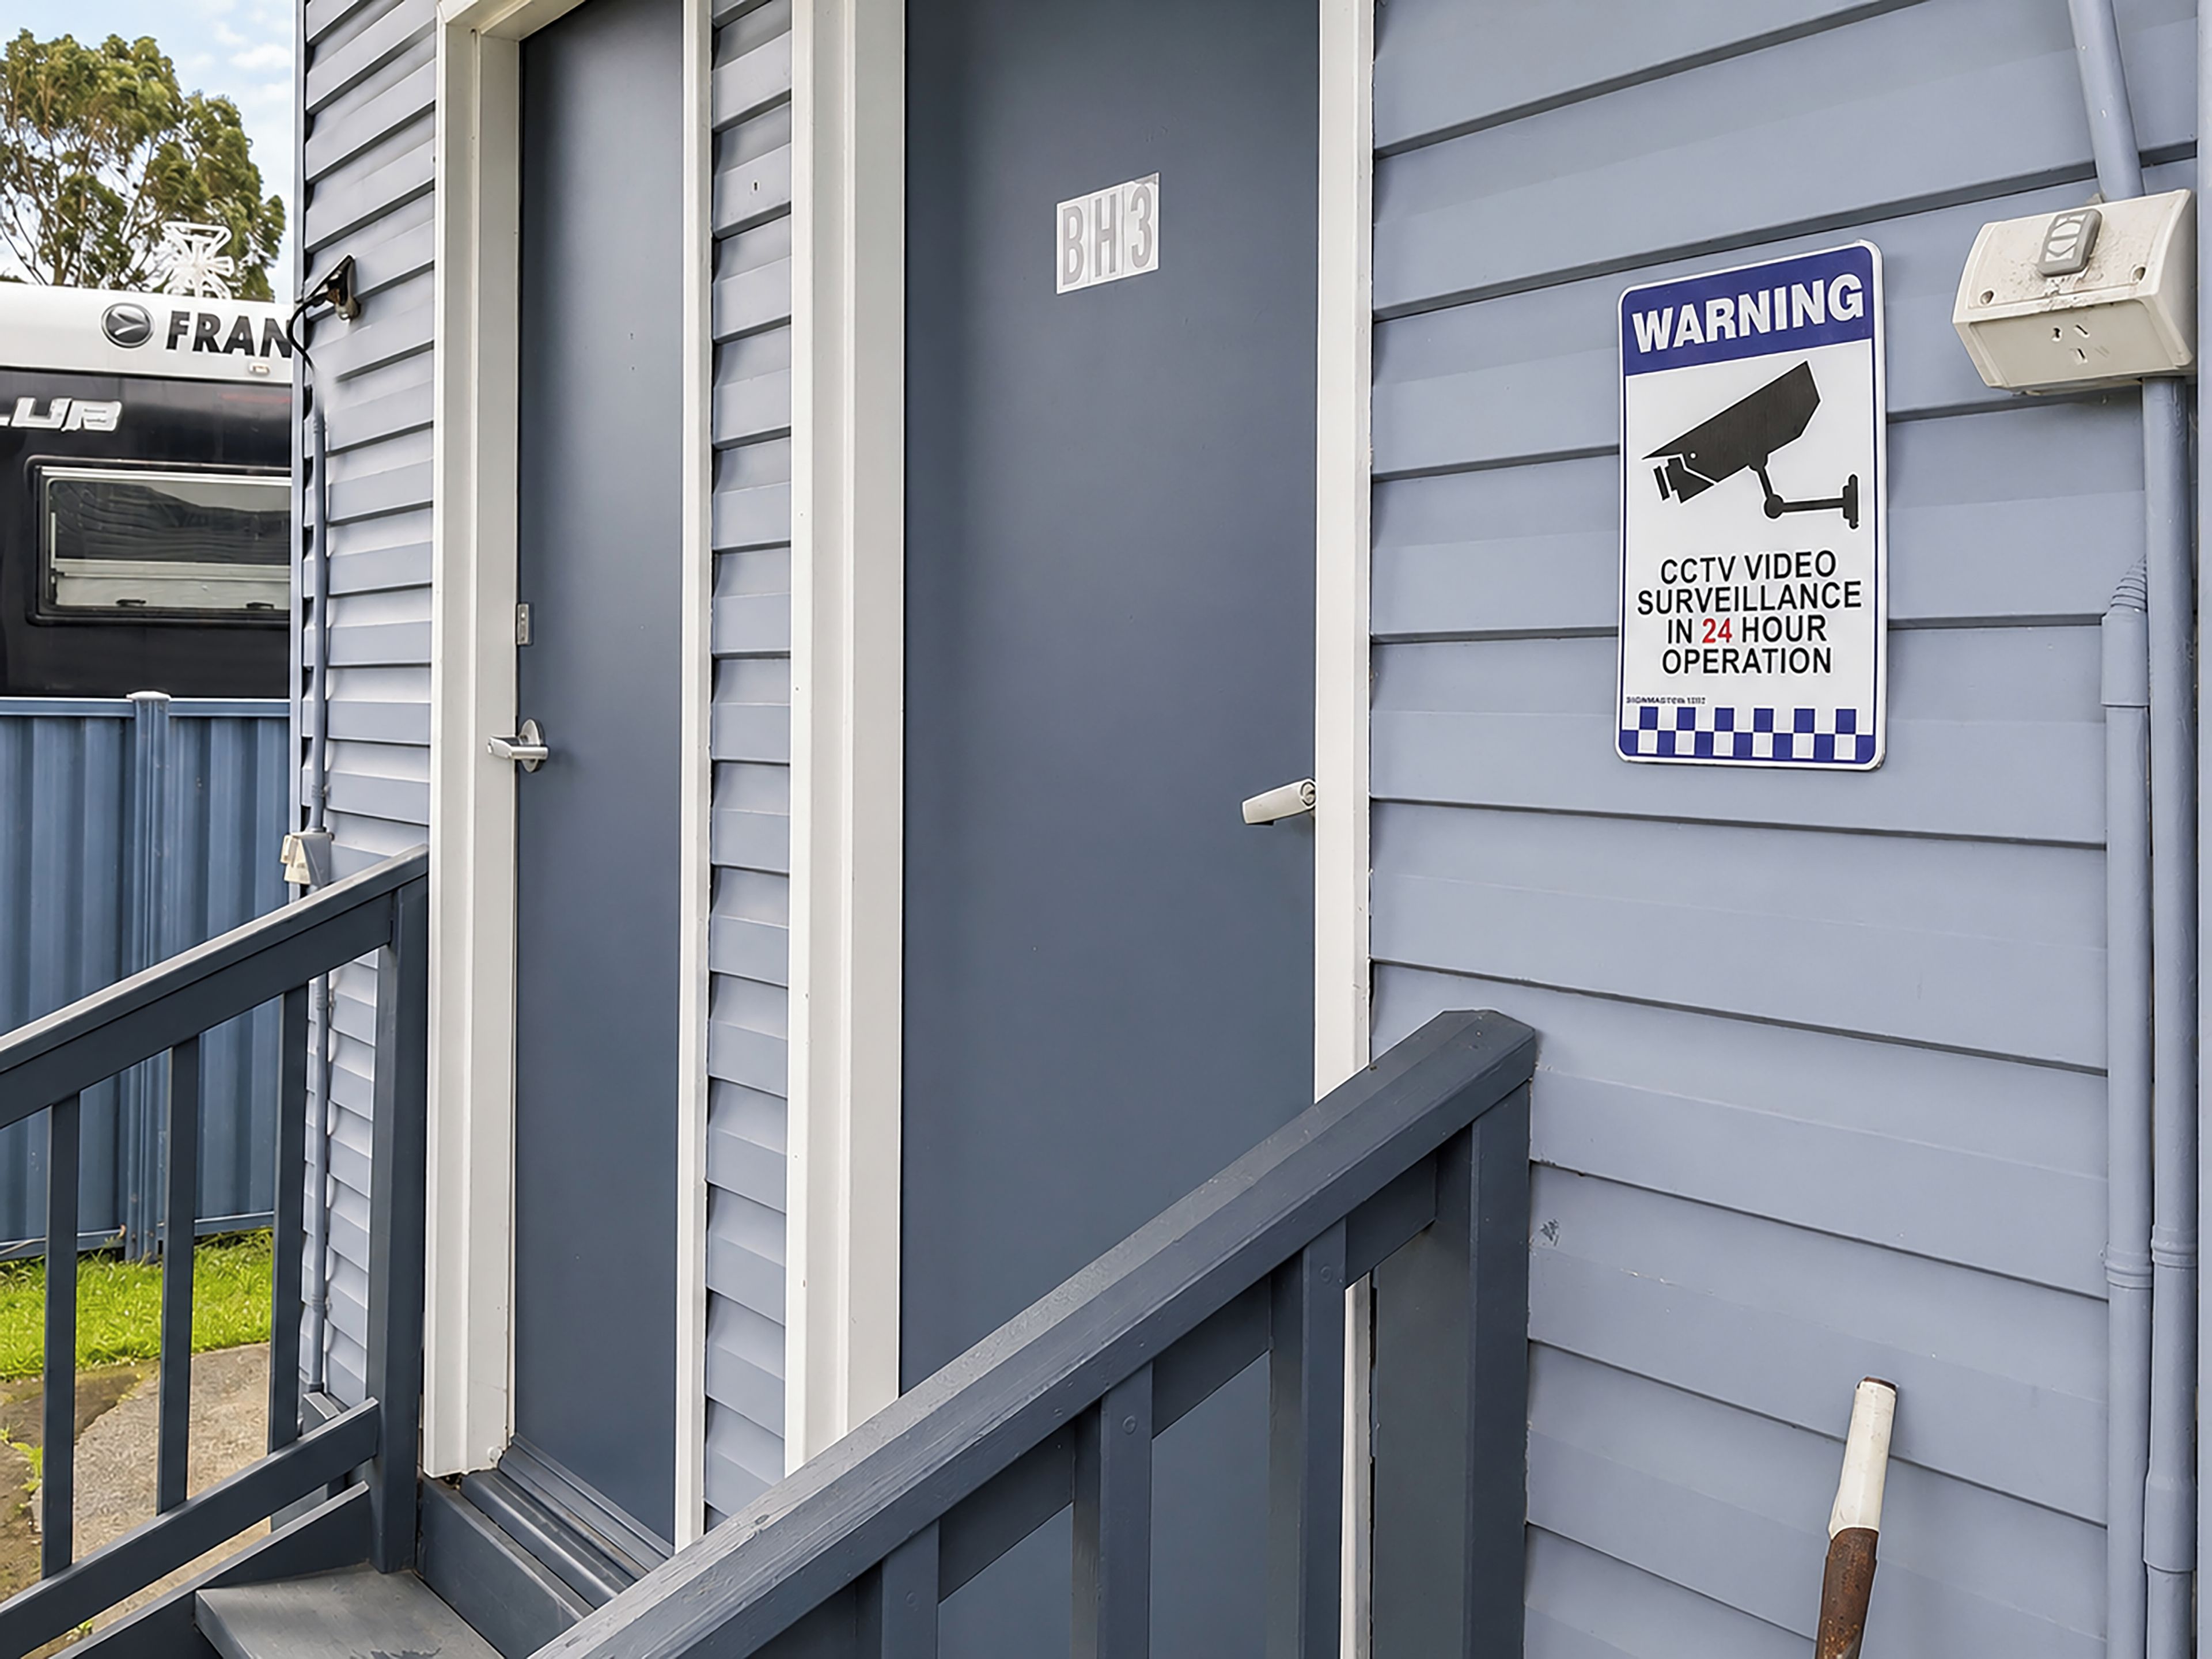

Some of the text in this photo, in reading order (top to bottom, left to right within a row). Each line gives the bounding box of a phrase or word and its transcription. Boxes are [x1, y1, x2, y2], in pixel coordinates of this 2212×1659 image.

[1063, 184, 1152, 285] BH3
[1632, 273, 1863, 353] WARNING
[166, 310, 293, 358] FRAN
[0, 397, 122, 431] UB
[1661, 550, 1836, 584] CCTV VIDEO
[1637, 580, 1862, 615] SURVEILLANCE
[1668, 614, 1827, 644] IN 24 HOUR
[1662, 647, 1831, 674] OPERATION
